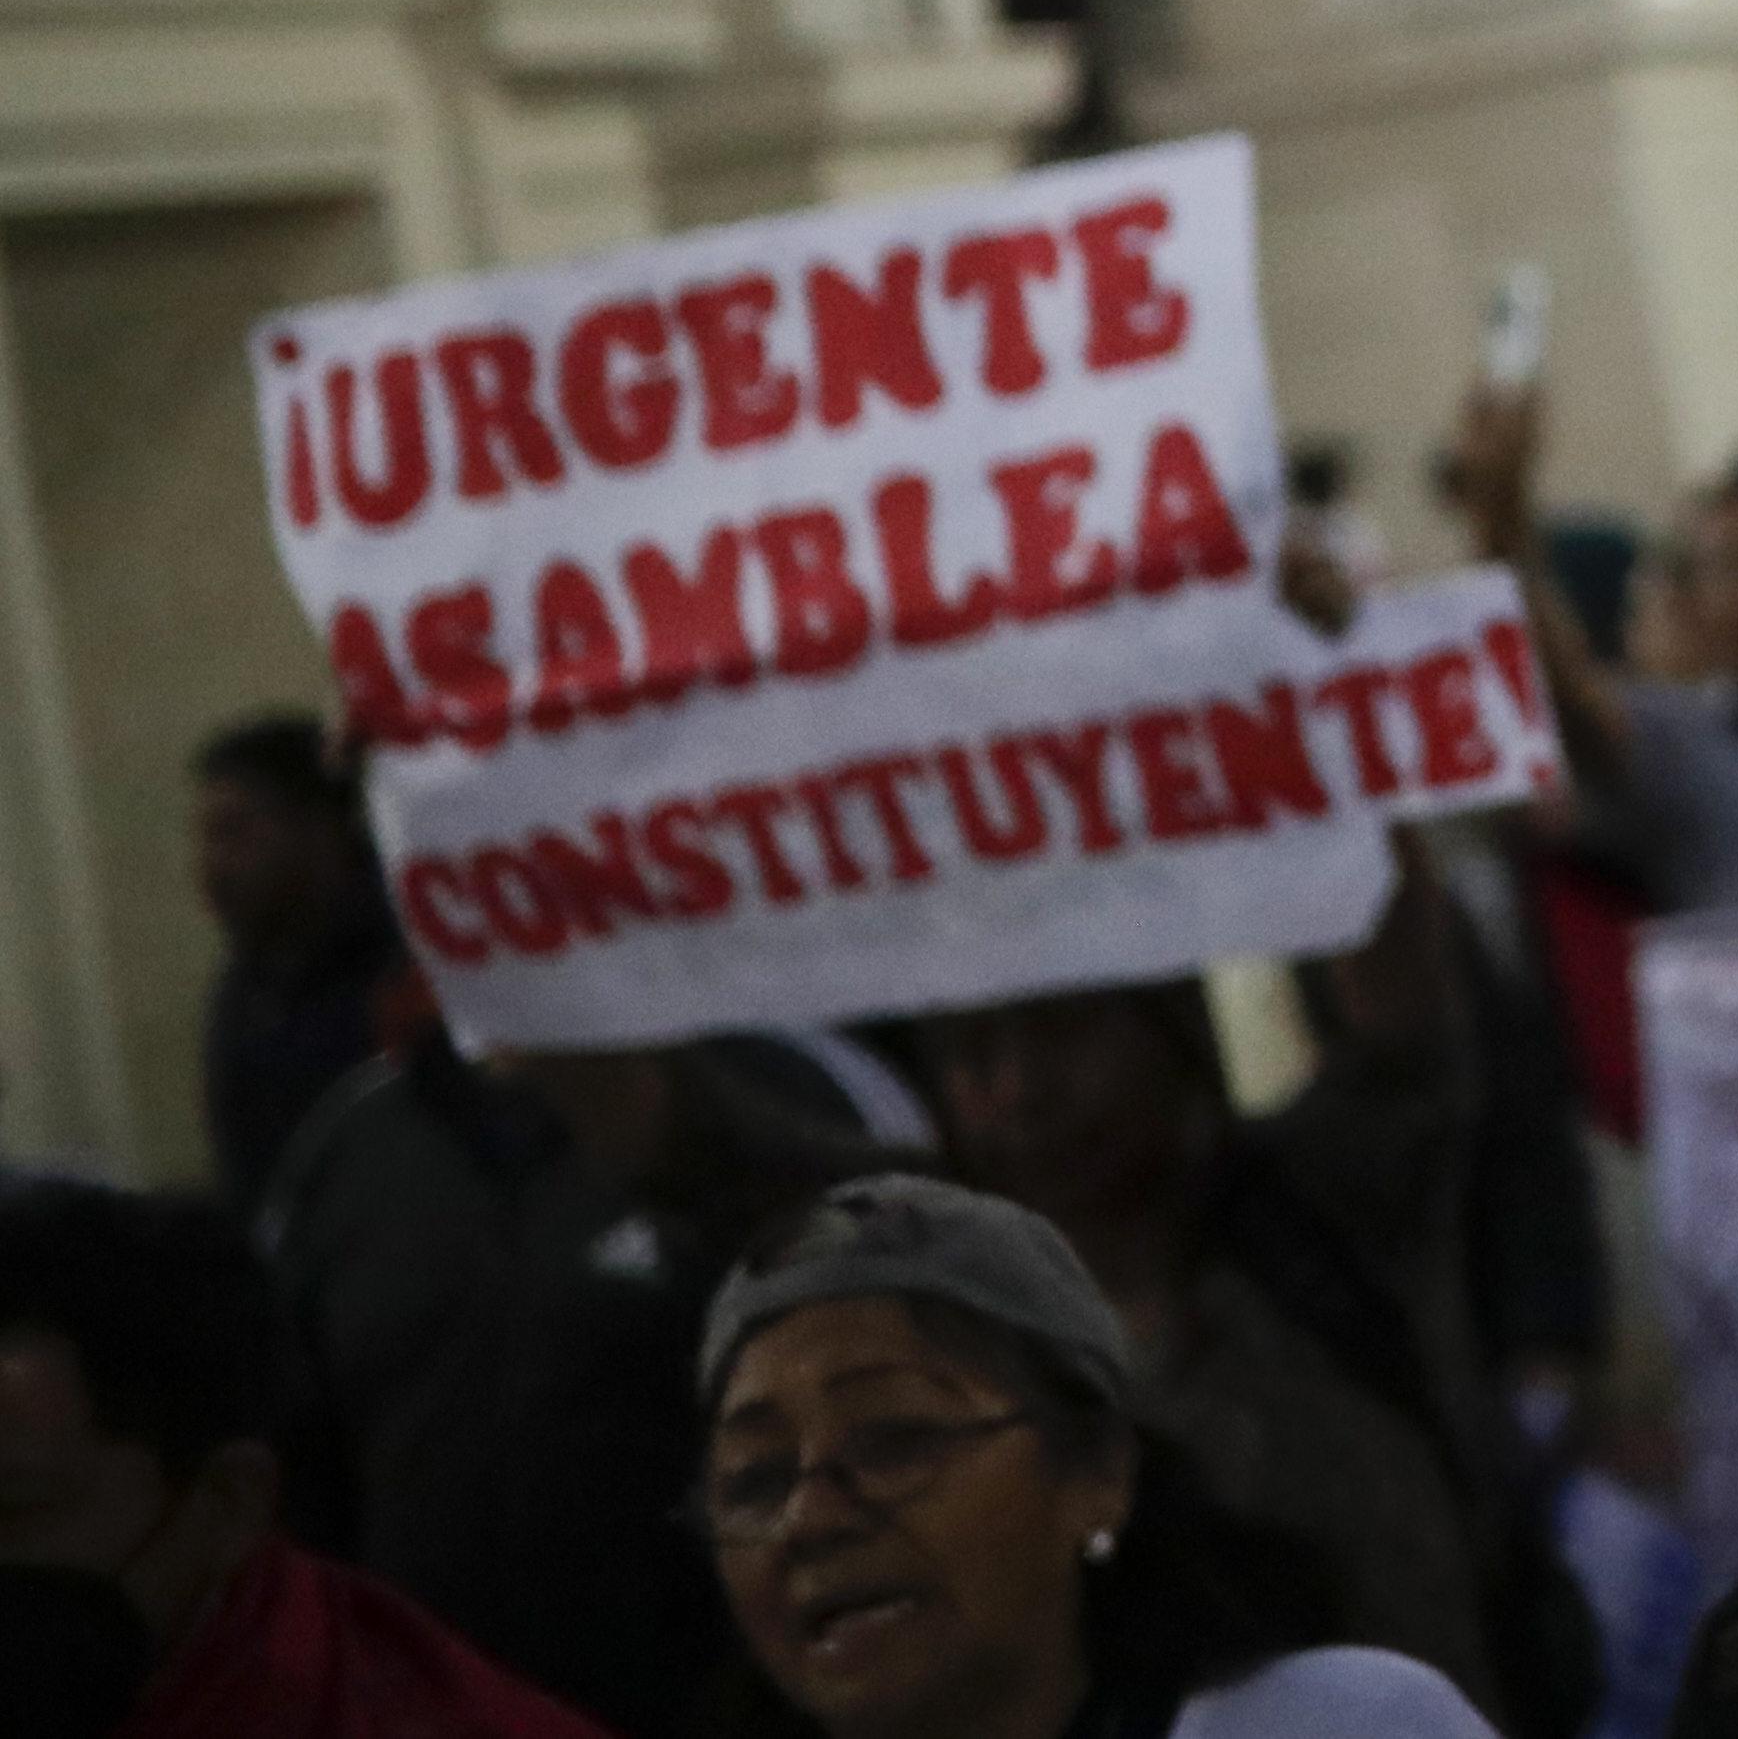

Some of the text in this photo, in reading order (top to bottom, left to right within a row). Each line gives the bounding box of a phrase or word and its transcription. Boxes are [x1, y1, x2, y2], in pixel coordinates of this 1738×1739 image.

[270, 196, 1192, 530] ¡URGENTE
[328, 424, 1250, 754] ASAMBLEA
[404, 620, 1560, 958] CONSTITUYENTE!
